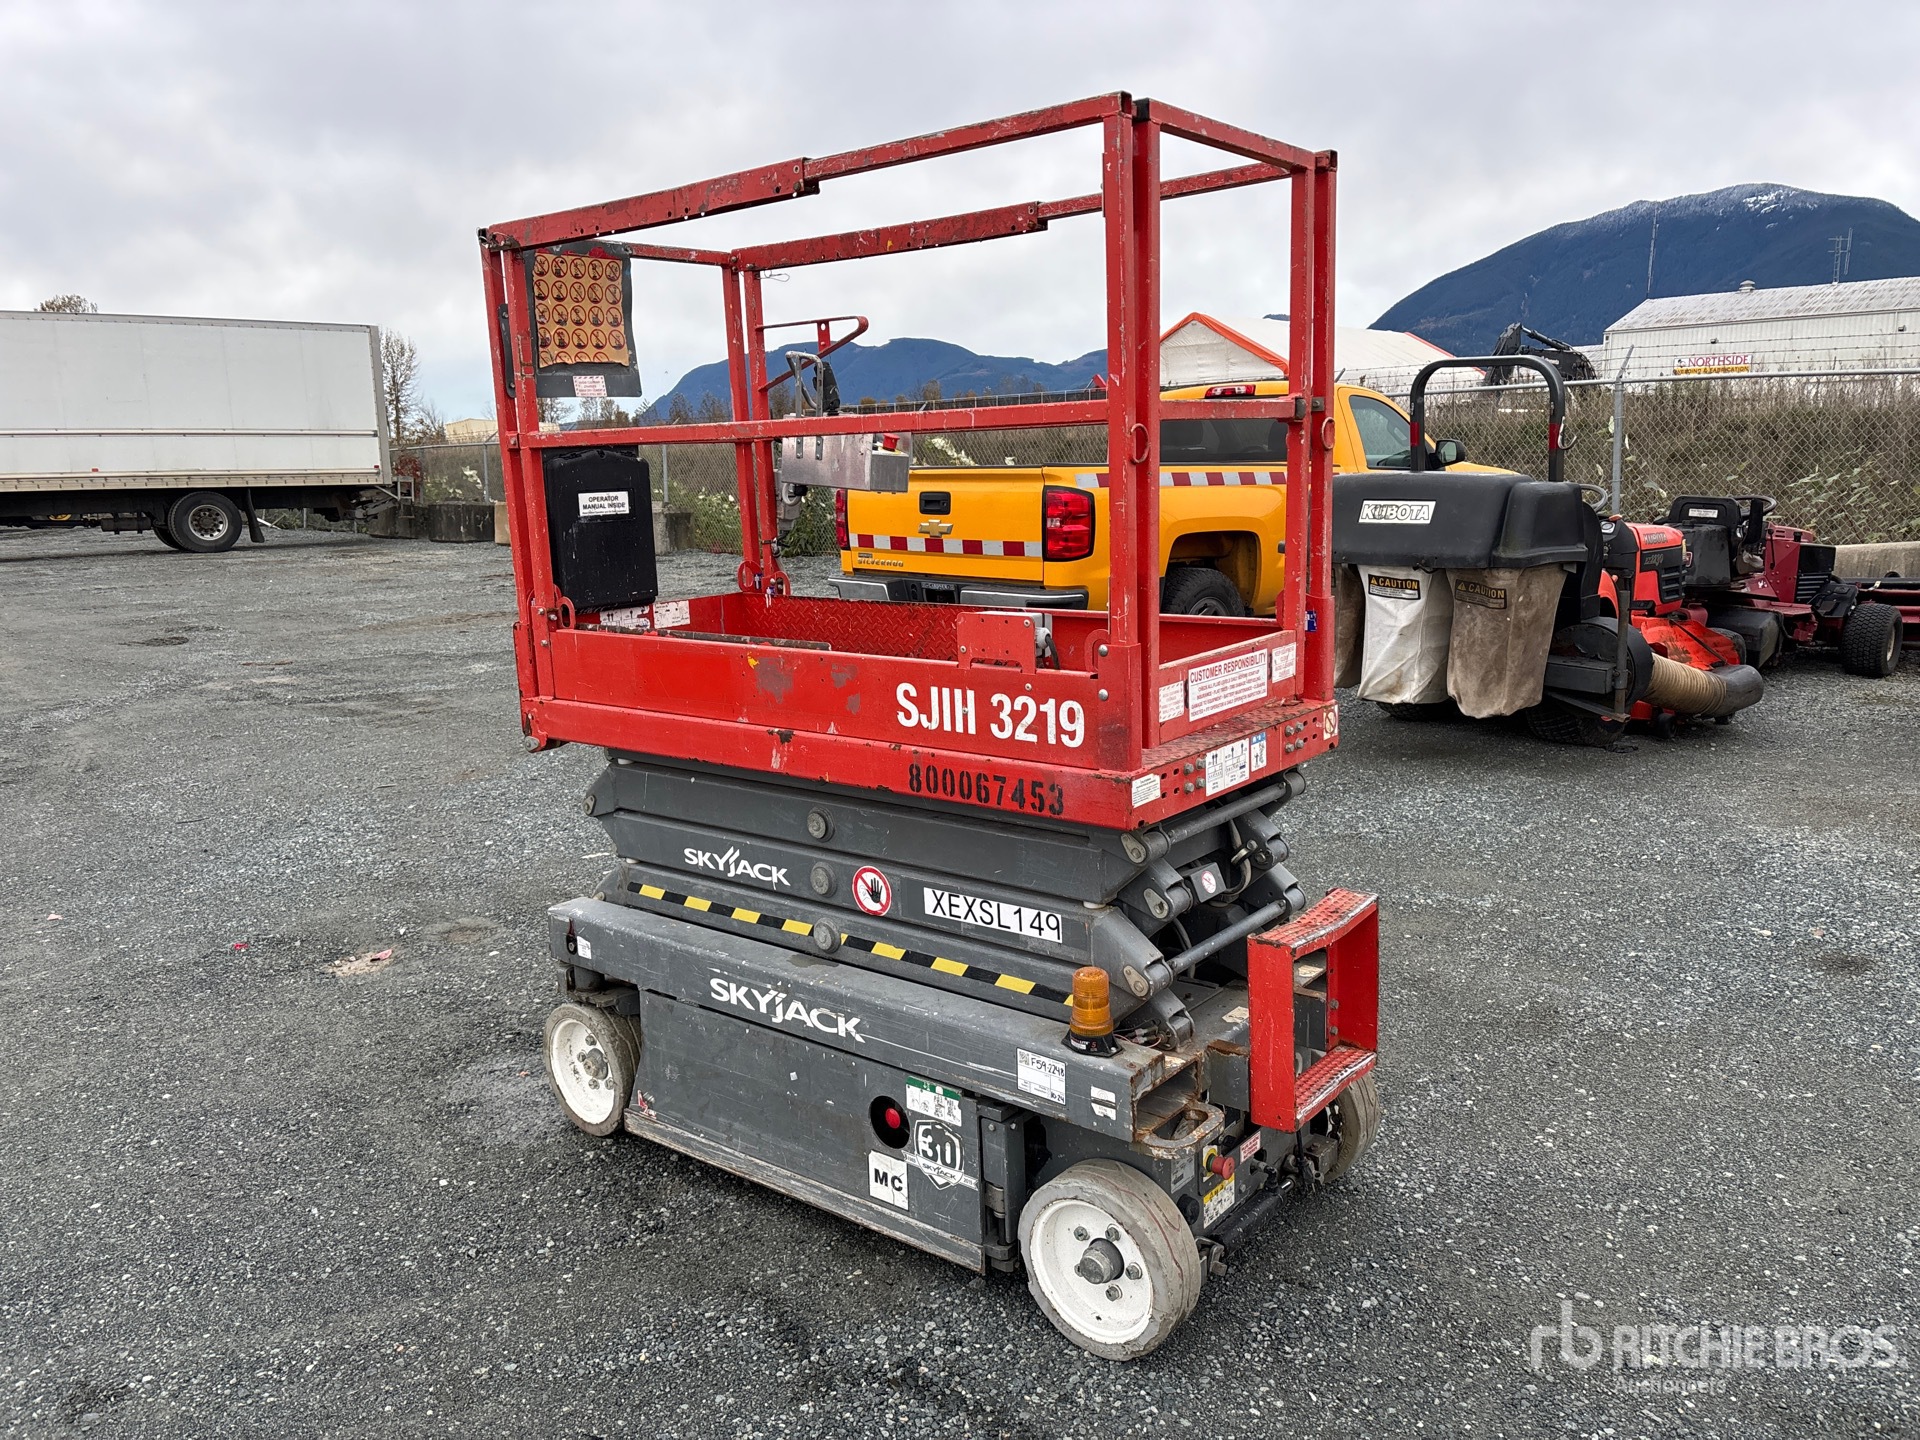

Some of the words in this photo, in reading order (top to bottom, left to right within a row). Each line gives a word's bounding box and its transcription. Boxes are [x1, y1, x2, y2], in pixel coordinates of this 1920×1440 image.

[1688, 355, 1749, 367] NORTHSIDE
[1361, 504, 1430, 520] KUBOTA
[1643, 531, 1668, 545] KUBOTA
[1378, 577, 1418, 590] CAUTION
[1468, 583, 1505, 599] CAUTION
[1190, 664, 1222, 684] CUSTOMER
[1224, 652, 1266, 674] RESPONSIBILITY
[990, 693, 1085, 748] 3219
[908, 763, 1064, 816] 800067453
[683, 846, 791, 887] SKYJACK
[932, 889, 1061, 941] XEXSL149
[709, 978, 866, 1043] SKYJACK
[921, 1127, 957, 1171] 30
[874, 1168, 903, 1192] MC
[922, 1162, 957, 1182] SKYJACK
